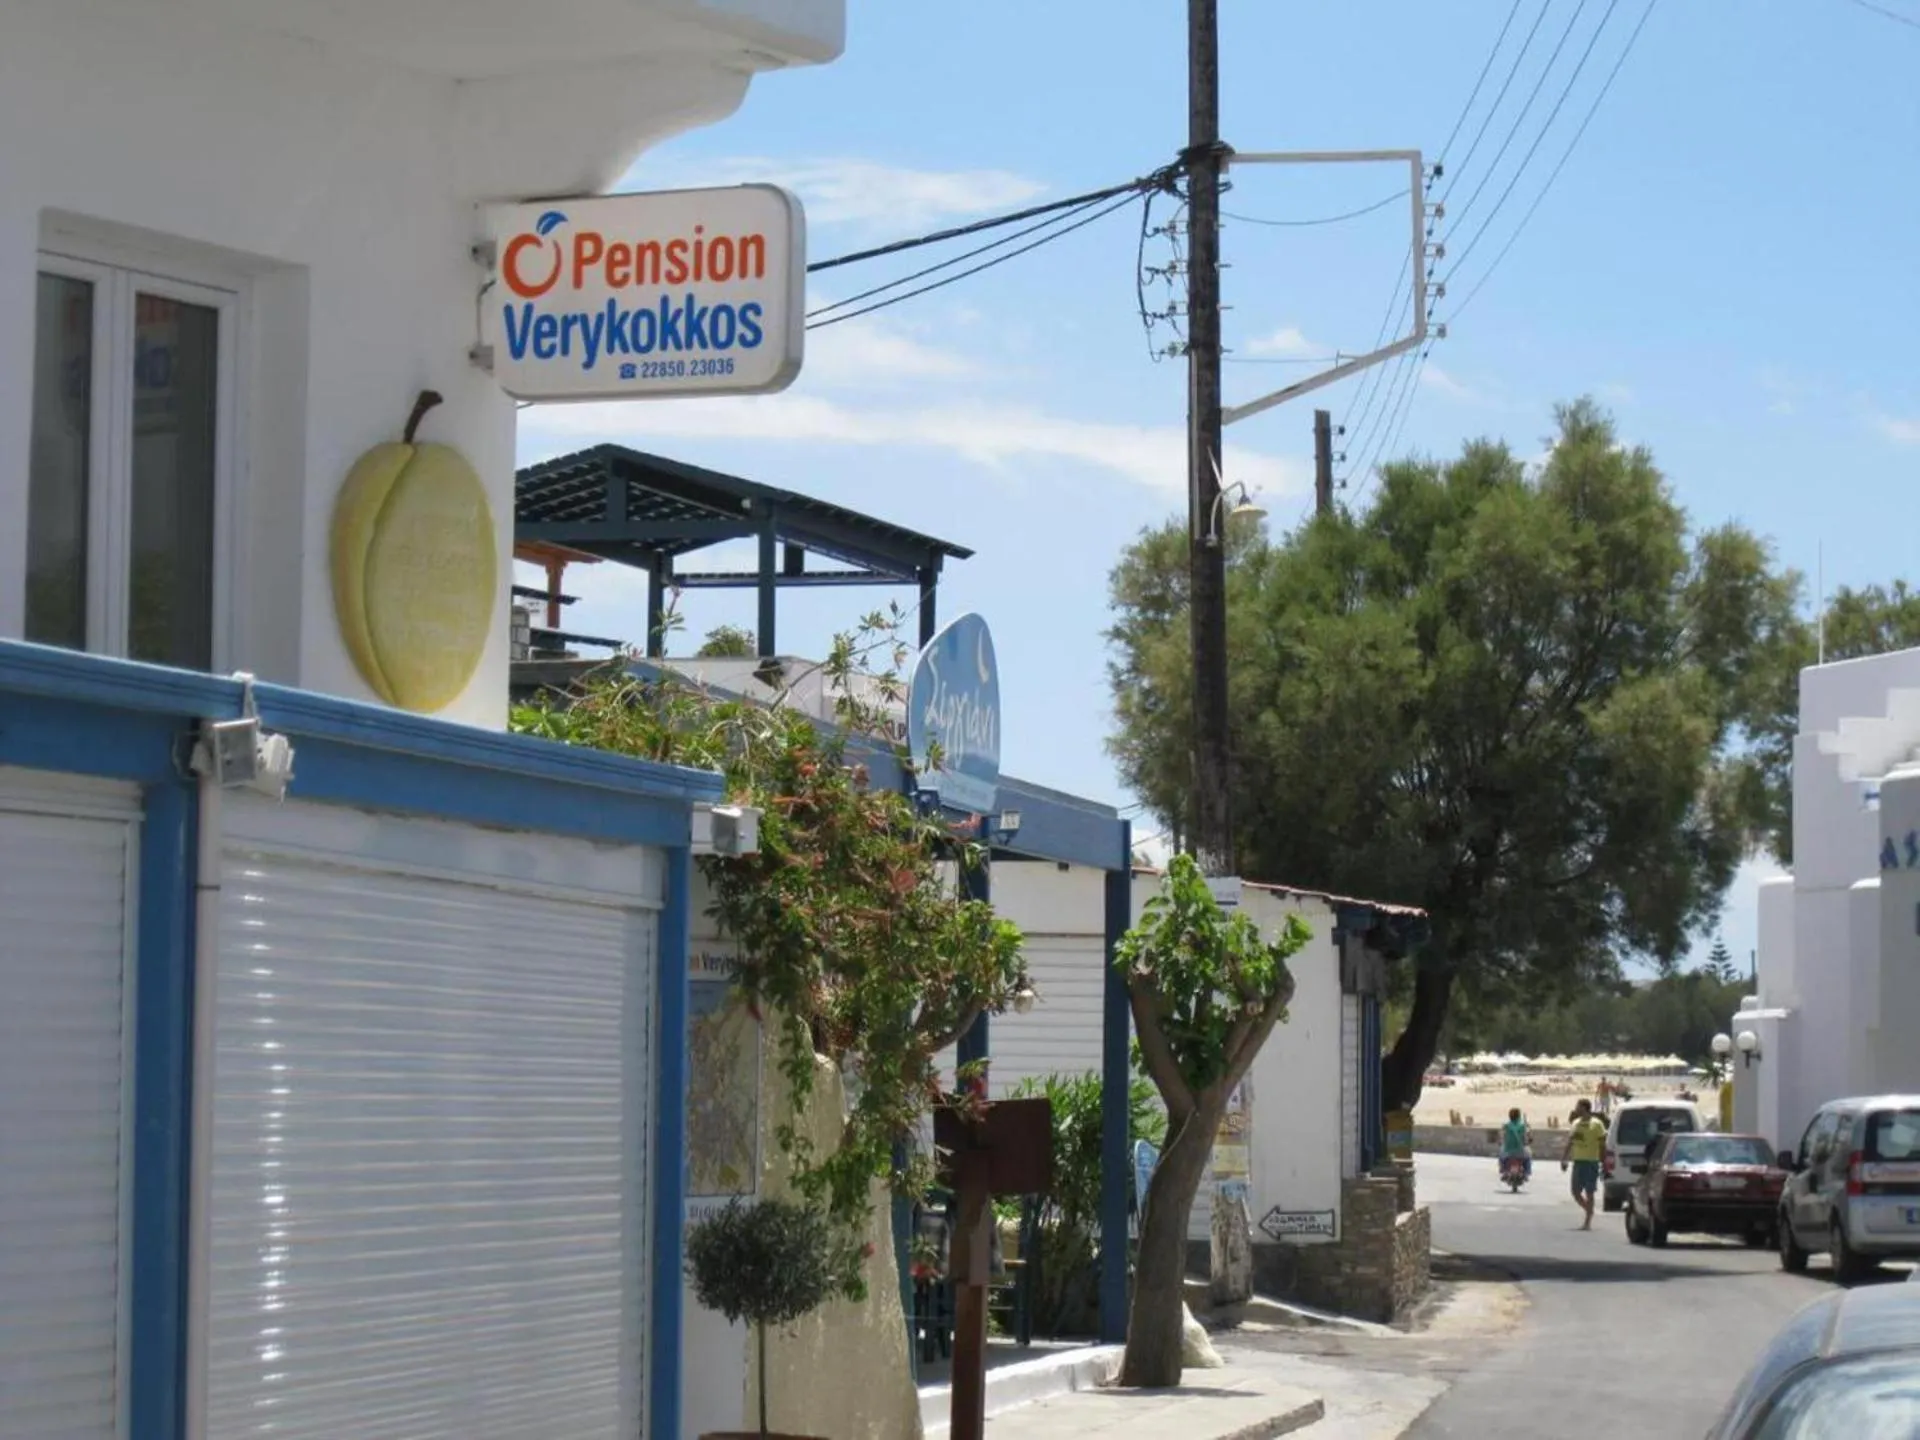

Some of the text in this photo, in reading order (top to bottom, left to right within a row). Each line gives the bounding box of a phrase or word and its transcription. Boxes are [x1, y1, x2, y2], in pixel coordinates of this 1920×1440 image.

[573, 225, 765, 290] Pension
[503, 293, 763, 370] Verykokkos
[641, 358, 734, 379] 22850.23036
